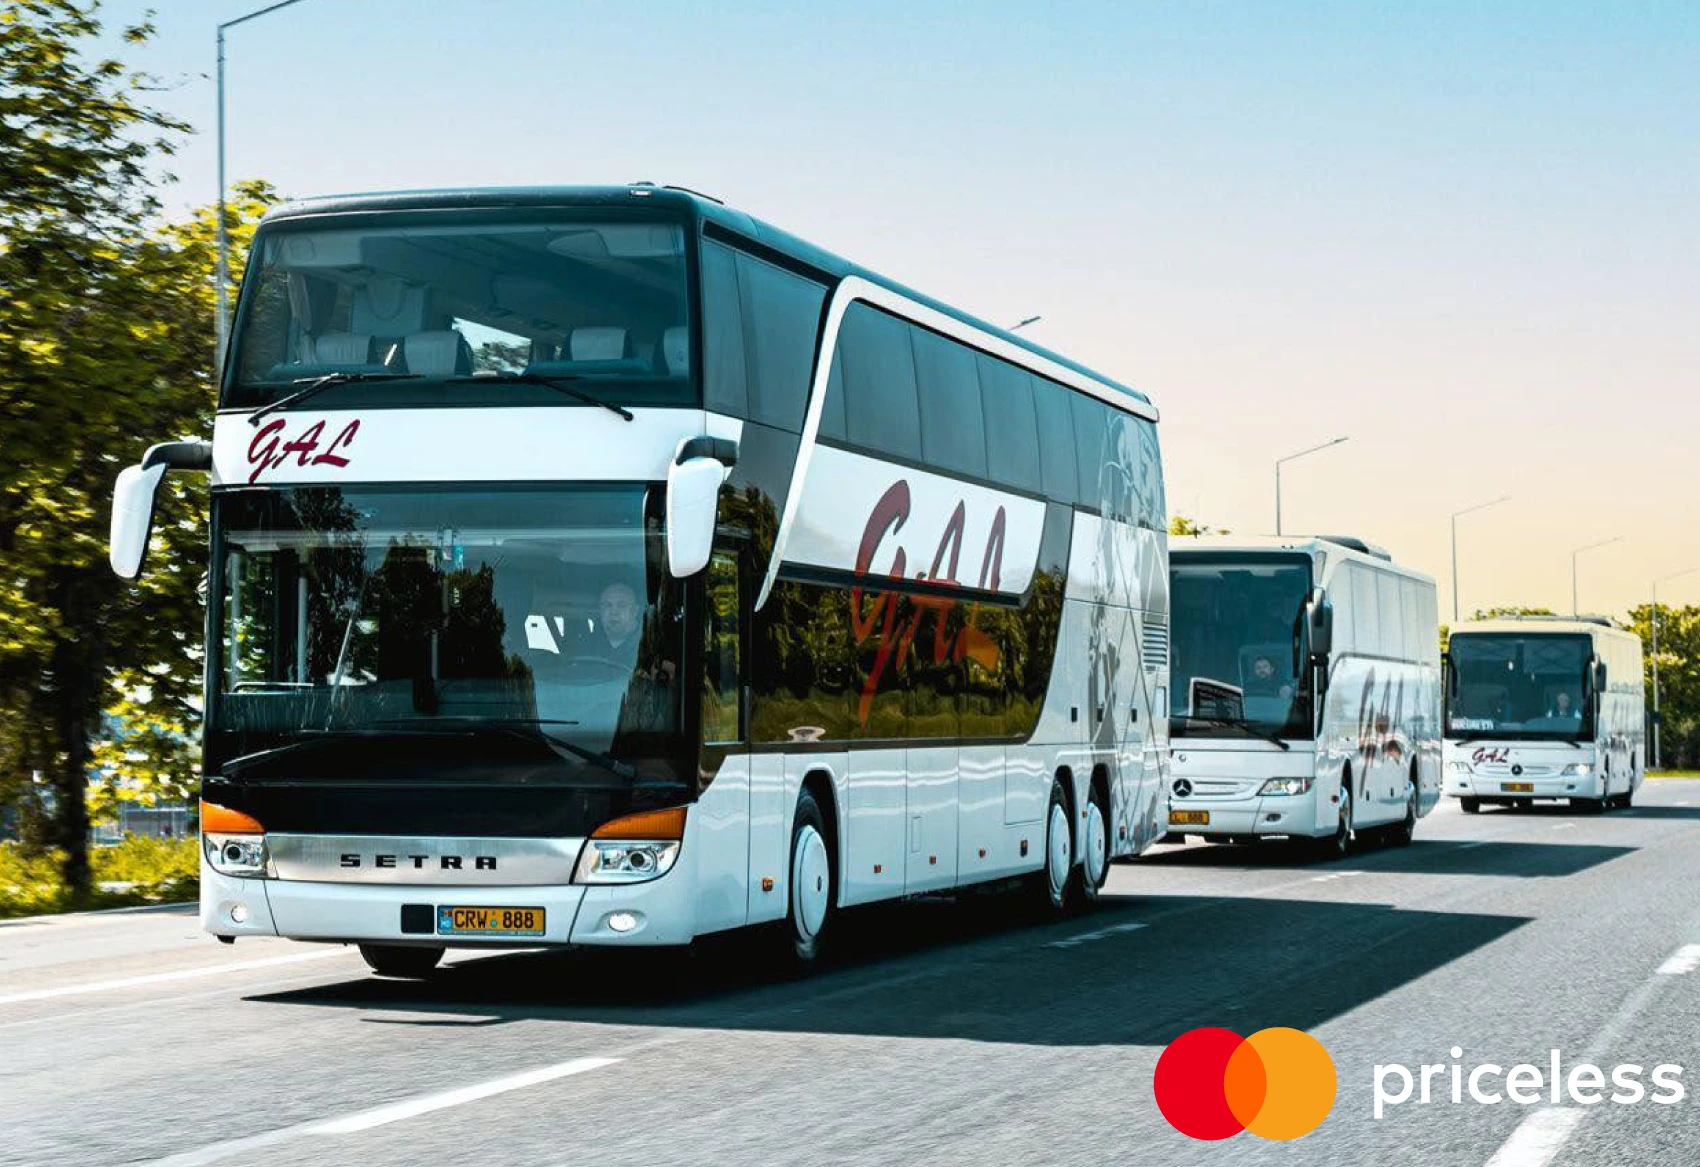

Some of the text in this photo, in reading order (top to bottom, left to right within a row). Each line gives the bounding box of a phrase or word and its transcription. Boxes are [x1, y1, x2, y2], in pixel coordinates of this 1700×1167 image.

[247, 418, 361, 484] GAL
[851, 479, 1007, 729] GAL
[1471, 747, 1510, 766] GAL
[340, 853, 497, 870] SETRA
[454, 910, 487, 929] CRW
[502, 911, 534, 929] 888
